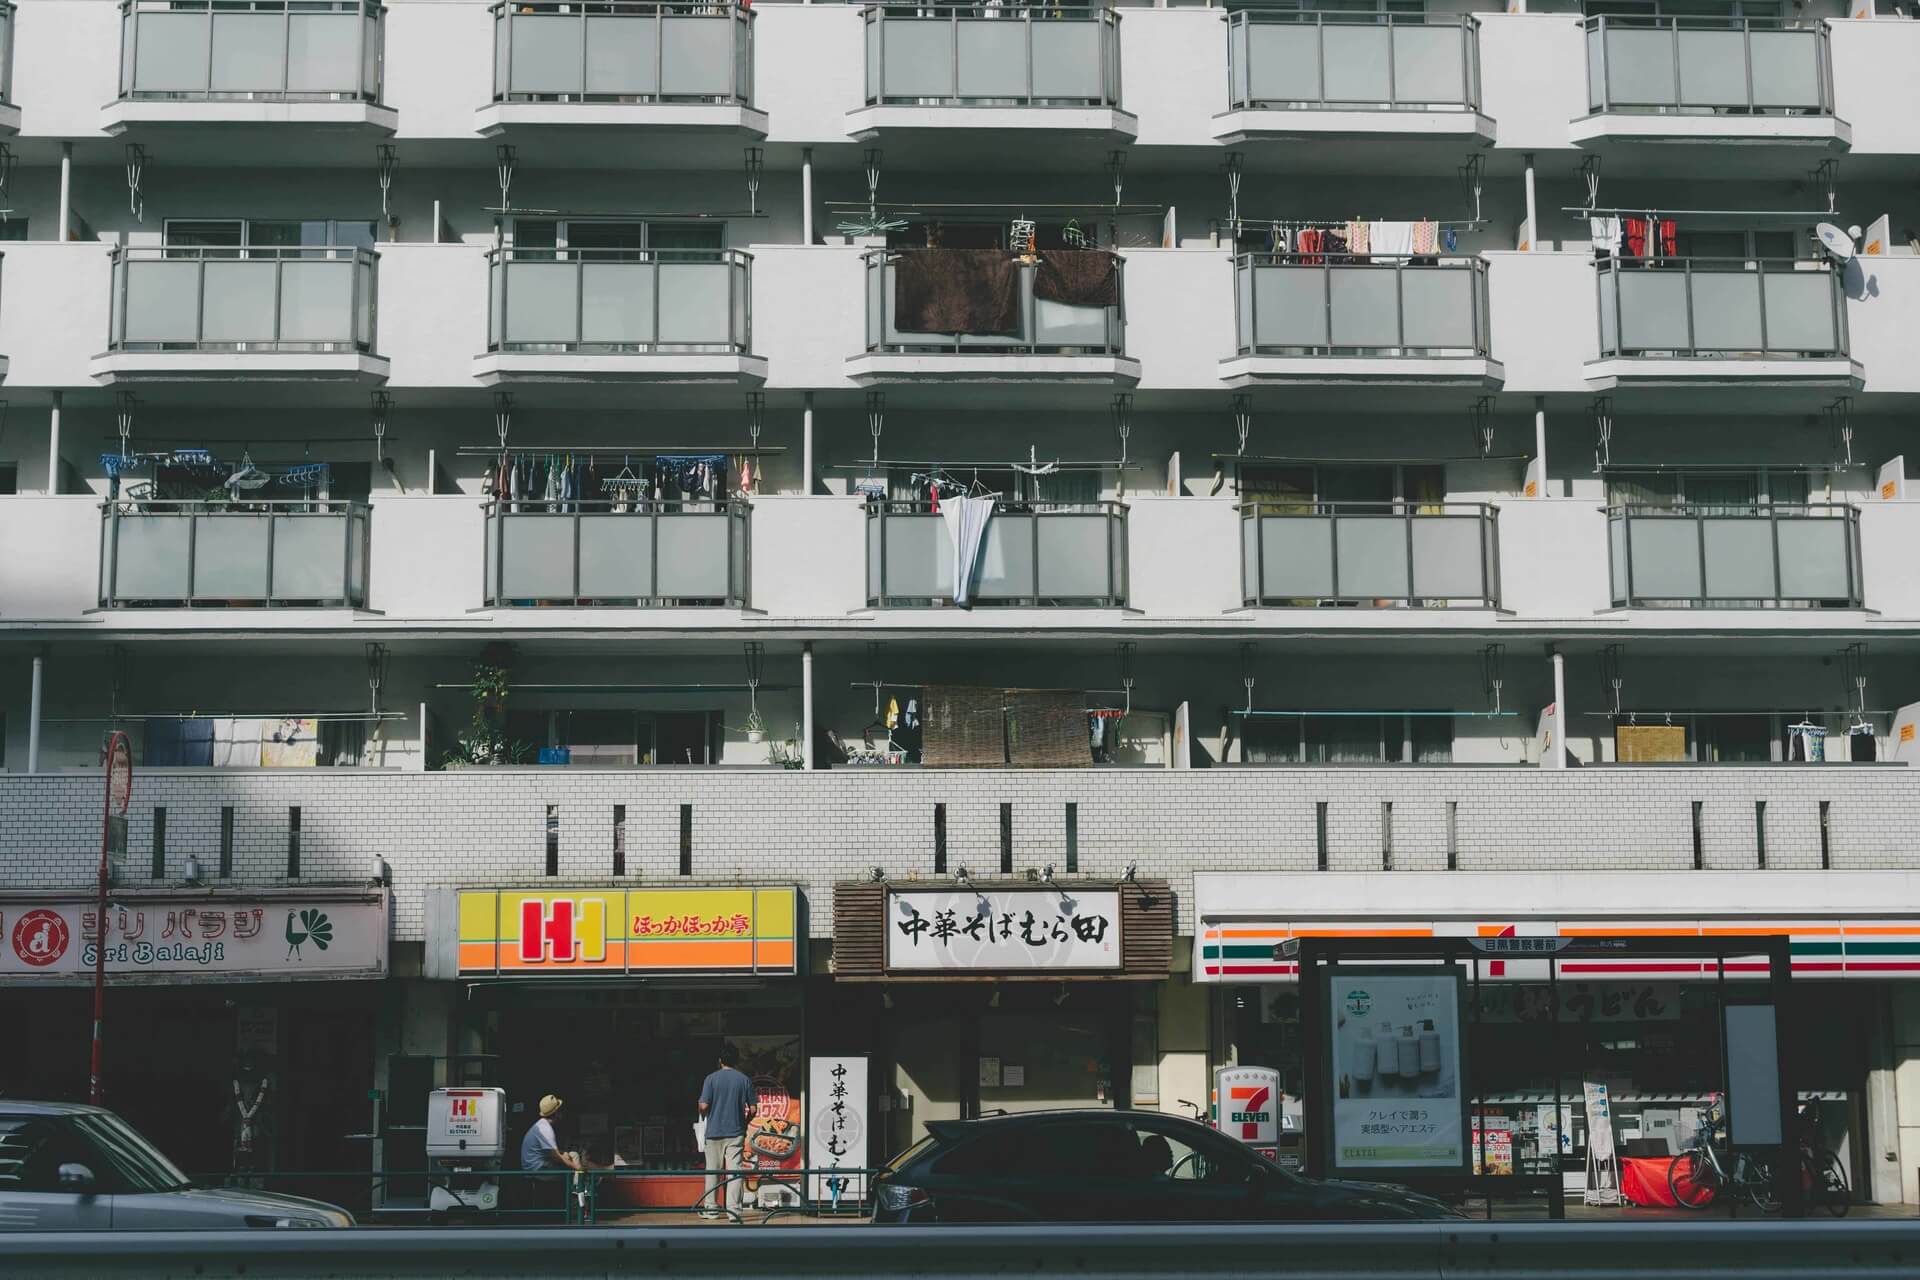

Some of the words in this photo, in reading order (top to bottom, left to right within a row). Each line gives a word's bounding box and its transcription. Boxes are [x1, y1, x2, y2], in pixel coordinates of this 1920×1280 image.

[632, 913, 751, 936] ほっかほっか亭
[898, 910, 1109, 947] 中華そばむら田
[1485, 939, 1557, 951] 目黒警察署前
[82, 942, 128, 966] Sri
[132, 942, 225, 965] Balaji
[1369, 1110, 1430, 1121] クレイで潤う
[1360, 1123, 1438, 1134] 実感型ヘアエステ
